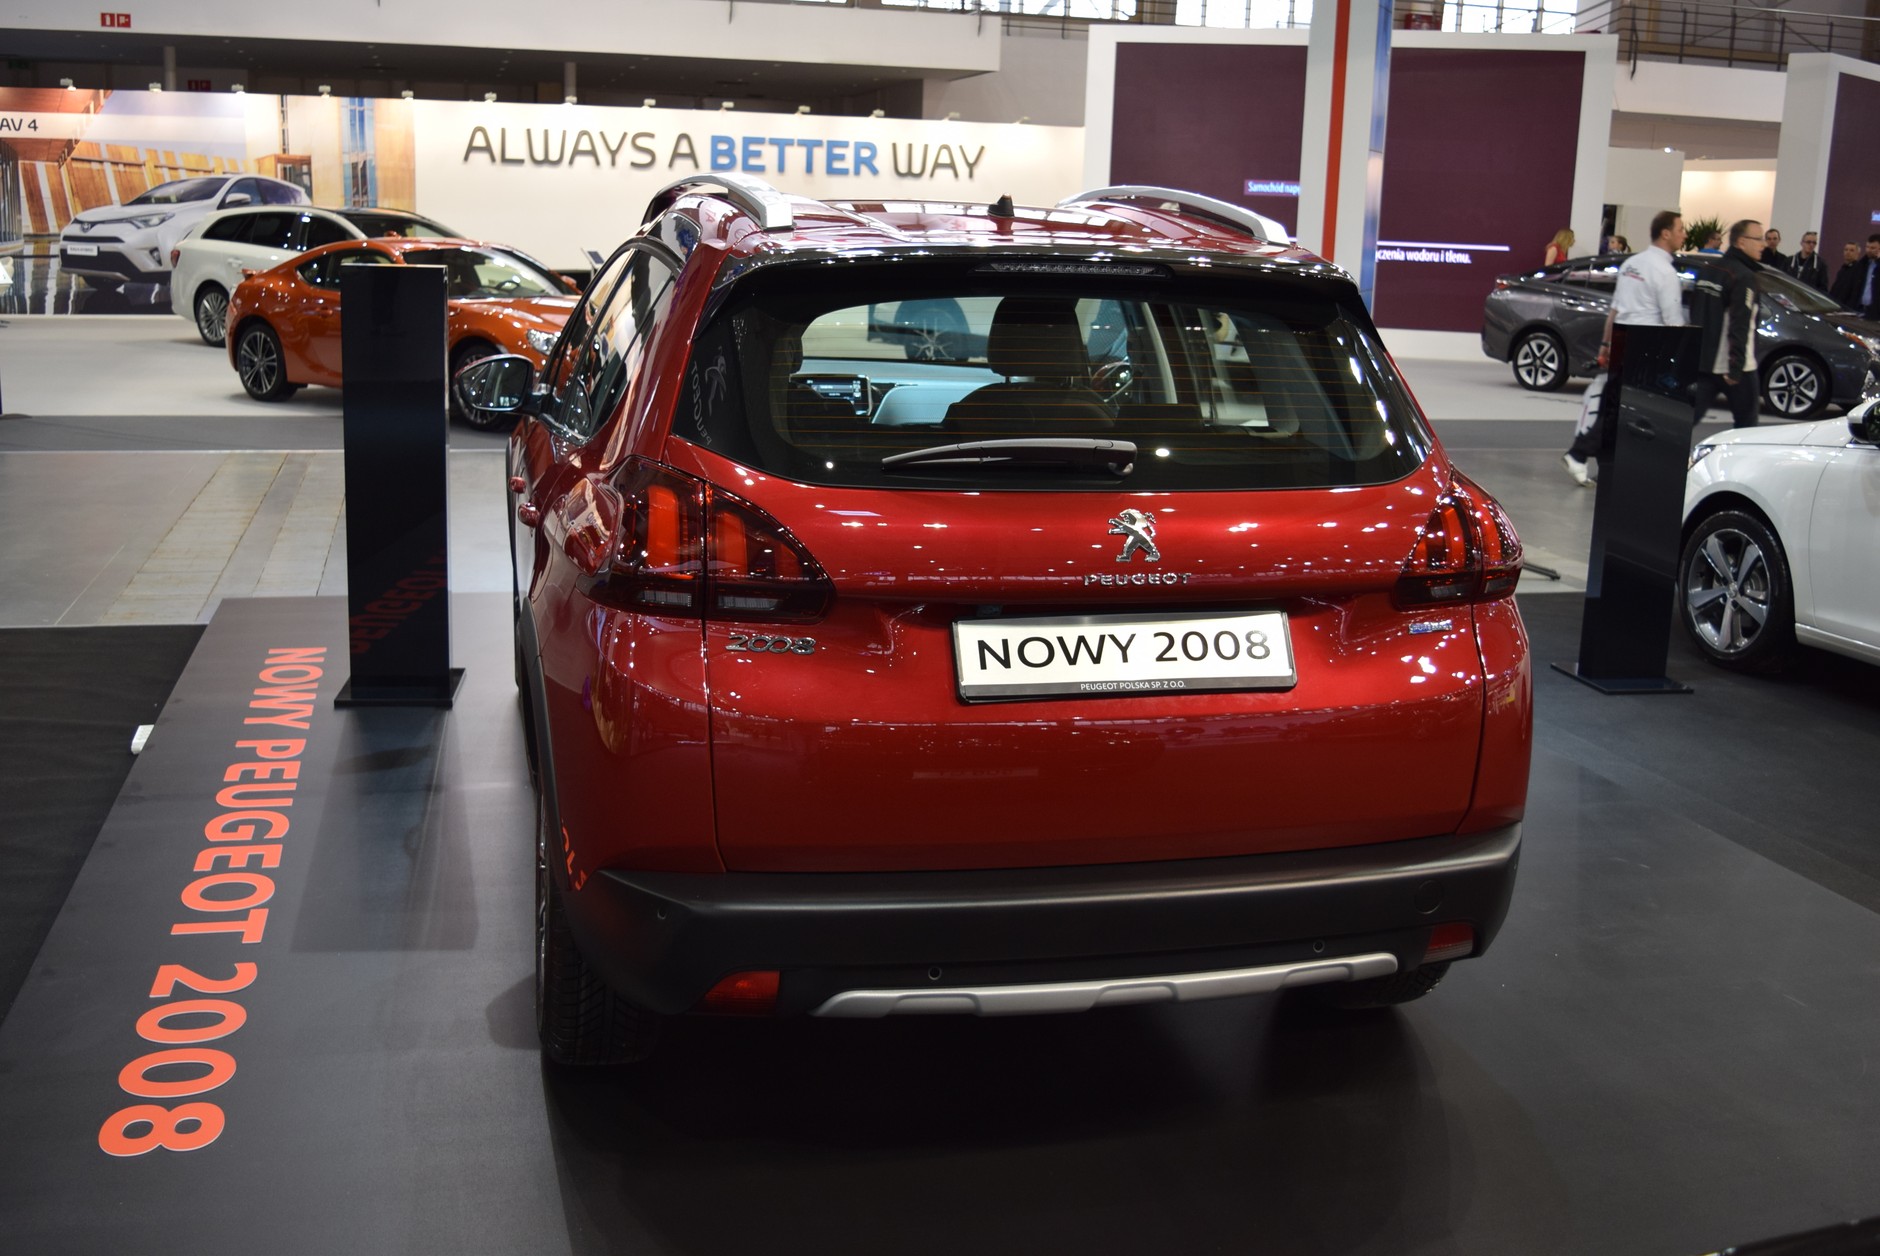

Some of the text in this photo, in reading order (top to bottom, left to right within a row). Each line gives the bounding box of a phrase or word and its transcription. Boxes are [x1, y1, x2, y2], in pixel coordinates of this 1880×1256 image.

[27, 118, 38, 132] 4
[463, 125, 986, 180] ALWAYS A BETTER WAY
[1406, 248, 1439, 262] wodoru
[1440, 250, 1445, 263] i
[1446, 250, 1472, 264] tlenu.
[1084, 572, 1192, 586] PEUGEOT
[725, 634, 817, 655] 2008
[977, 629, 1271, 671] NOWY 2008
[1080, 680, 1186, 691] PEUGEOT POLSKA SP. Z O.O.
[98, 646, 328, 1157] NOWY PEUGEOT 2008
